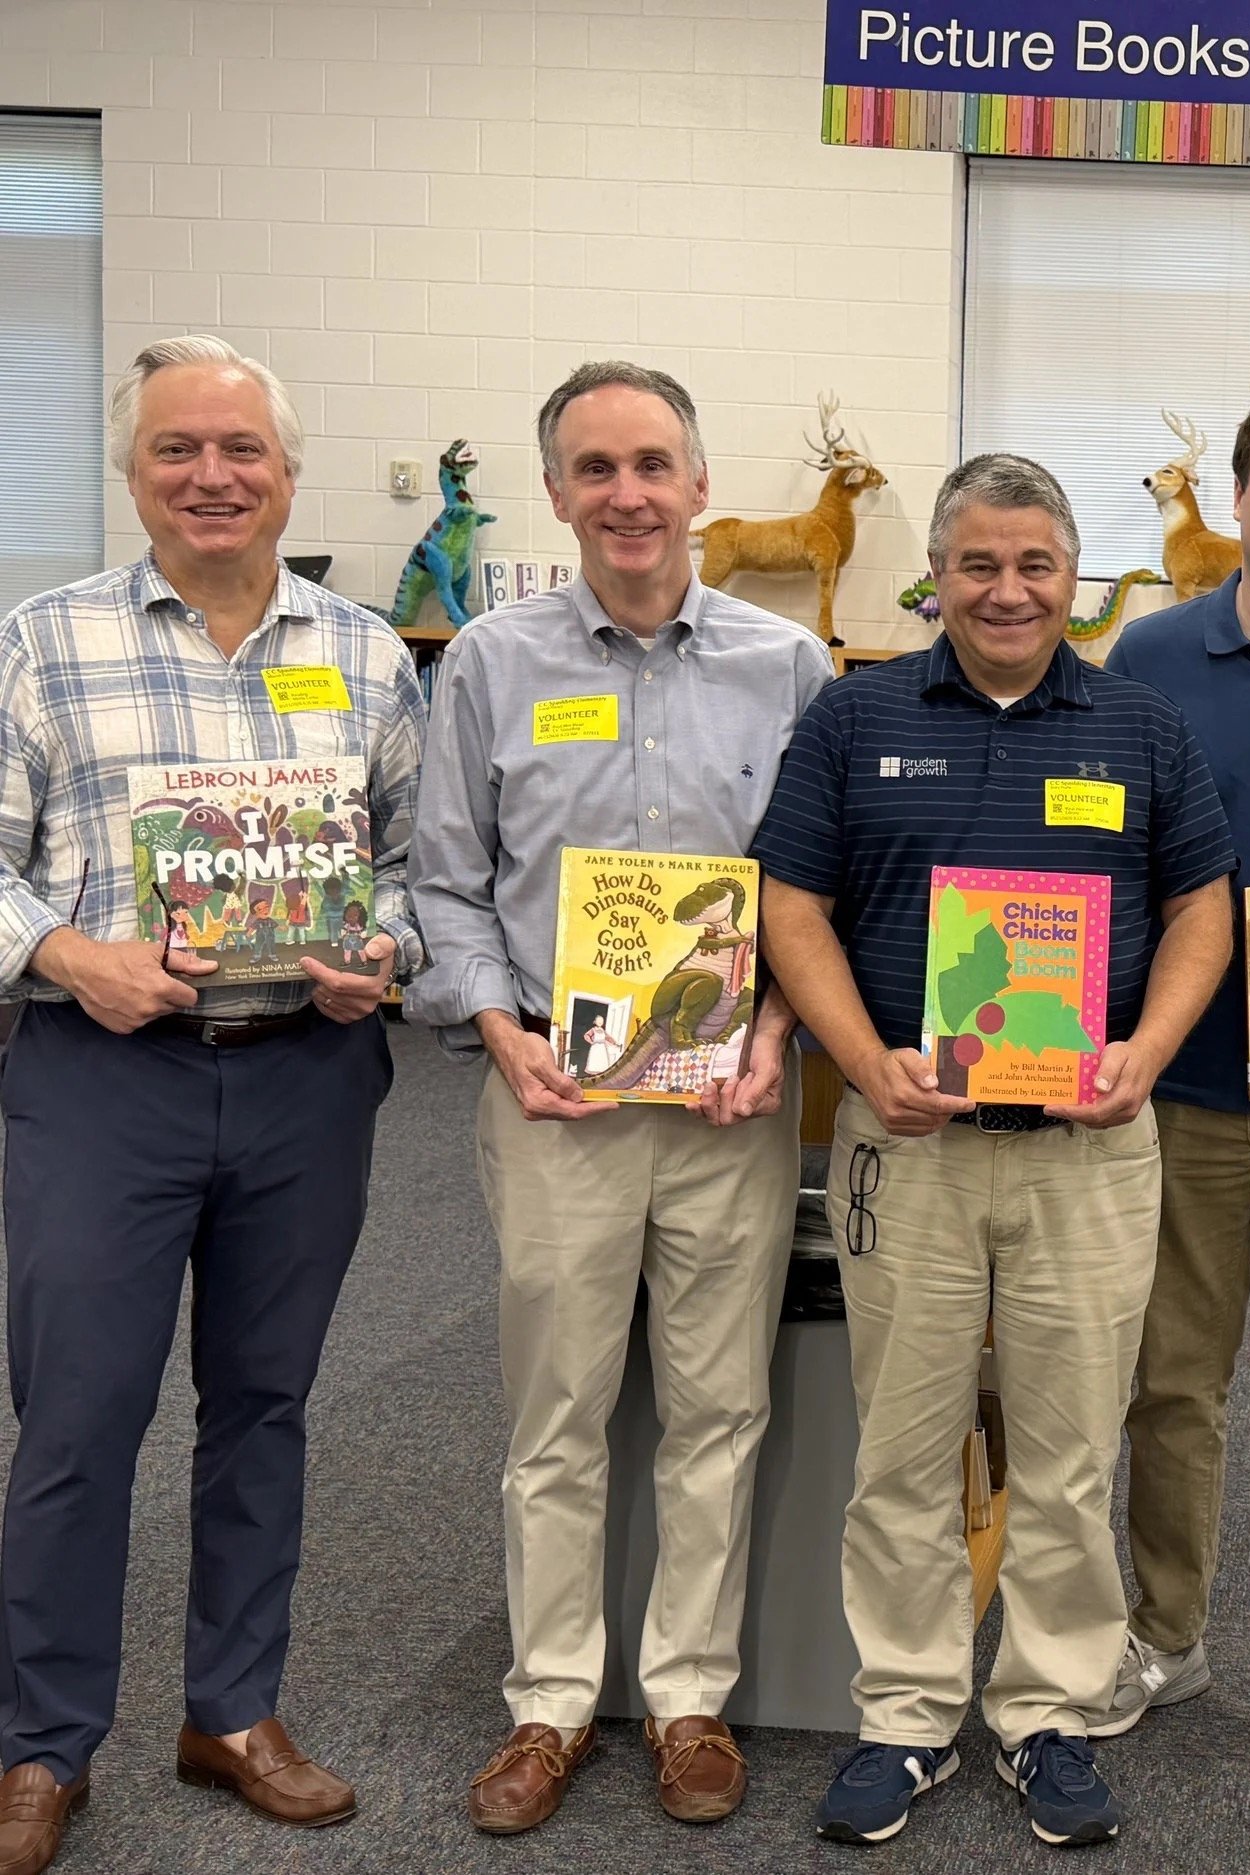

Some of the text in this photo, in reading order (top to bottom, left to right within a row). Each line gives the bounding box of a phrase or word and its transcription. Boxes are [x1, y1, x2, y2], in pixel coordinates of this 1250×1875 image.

[859, 9, 1250, 77] Picture Books
[526, 567, 533, 580] 1
[559, 568, 569, 582] 3
[271, 680, 331, 690] VOLUNTEER
[538, 710, 599, 722] VOLUNTEER
[902, 757, 948, 769] prudent
[906, 766, 948, 778] growth
[165, 767, 338, 789] LEBRON JAMES
[1050, 794, 1109, 805] VOLUNTEER
[241, 812, 265, 843] I
[155, 842, 359, 884] PROMISE
[584, 856, 614, 865] JANE
[618, 857, 654, 868] YOLEN
[668, 861, 703, 871] MARK
[707, 863, 754, 874] TEAGUE
[592, 871, 662, 896] How Do
[582, 892, 669, 925] Dinosaurs
[1003, 902, 1078, 922] Chicka
[609, 910, 640, 933] Say
[1003, 921, 1077, 941] Chicka
[597, 930, 648, 951] Good
[1015, 940, 1077, 960] Boom
[262, 964, 283, 972] NINA
[284, 962, 302, 970] MAT
[592, 948, 653, 976] Night?
[1013, 959, 1077, 979] Boom
[988, 1072, 1003, 1080] and
[1004, 1073, 1023, 1081] John
[1010, 1062, 1074, 1073] by Bill Martin Jr
[979, 1086, 1073, 1098] illustrated by Lois Ehlert
[1140, 1663, 1168, 1692] N
